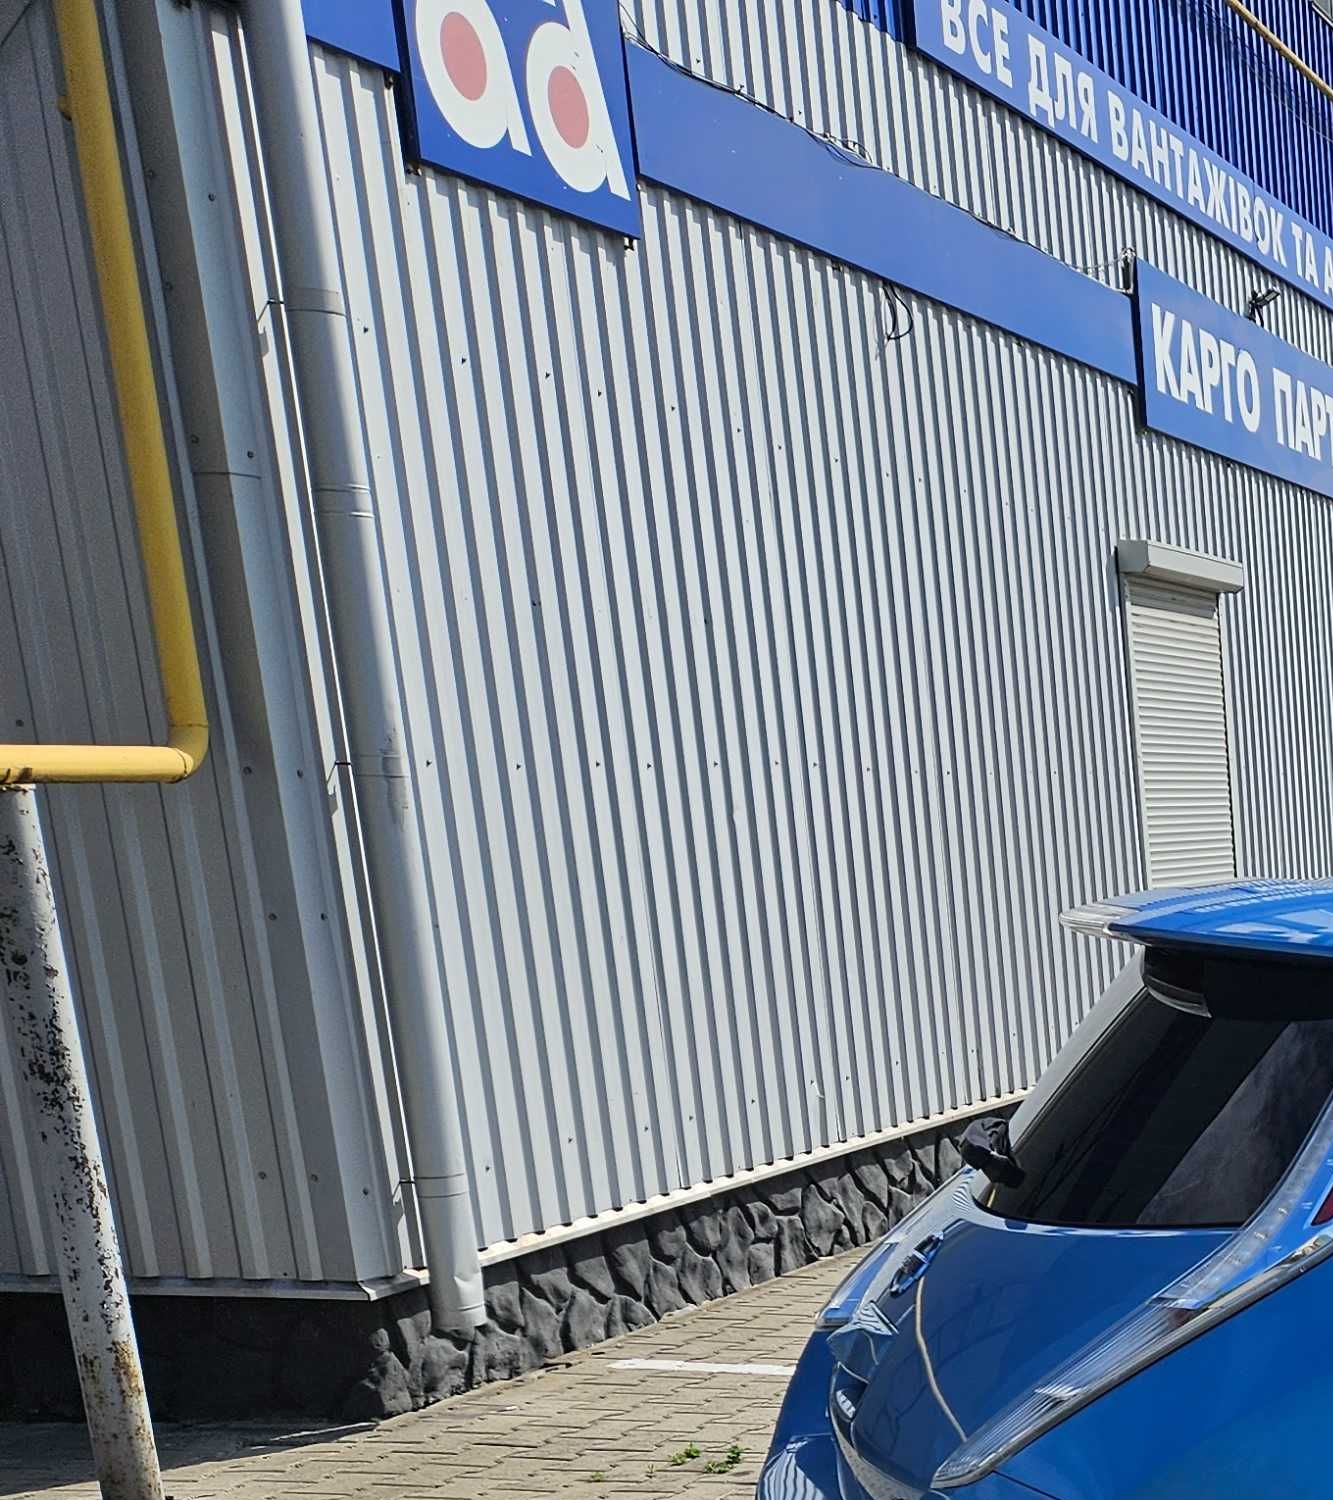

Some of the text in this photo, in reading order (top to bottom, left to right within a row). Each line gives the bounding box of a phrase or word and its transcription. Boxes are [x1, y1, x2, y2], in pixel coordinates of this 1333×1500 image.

[940, 0, 1013, 88] ВСЕ
[1028, 33, 1098, 143] ДЛЯ
[1107, 90, 1287, 268] ВАНТАЖІВОК
[1291, 222, 1319, 288] ТА
[1152, 302, 1260, 433] КАРГО
